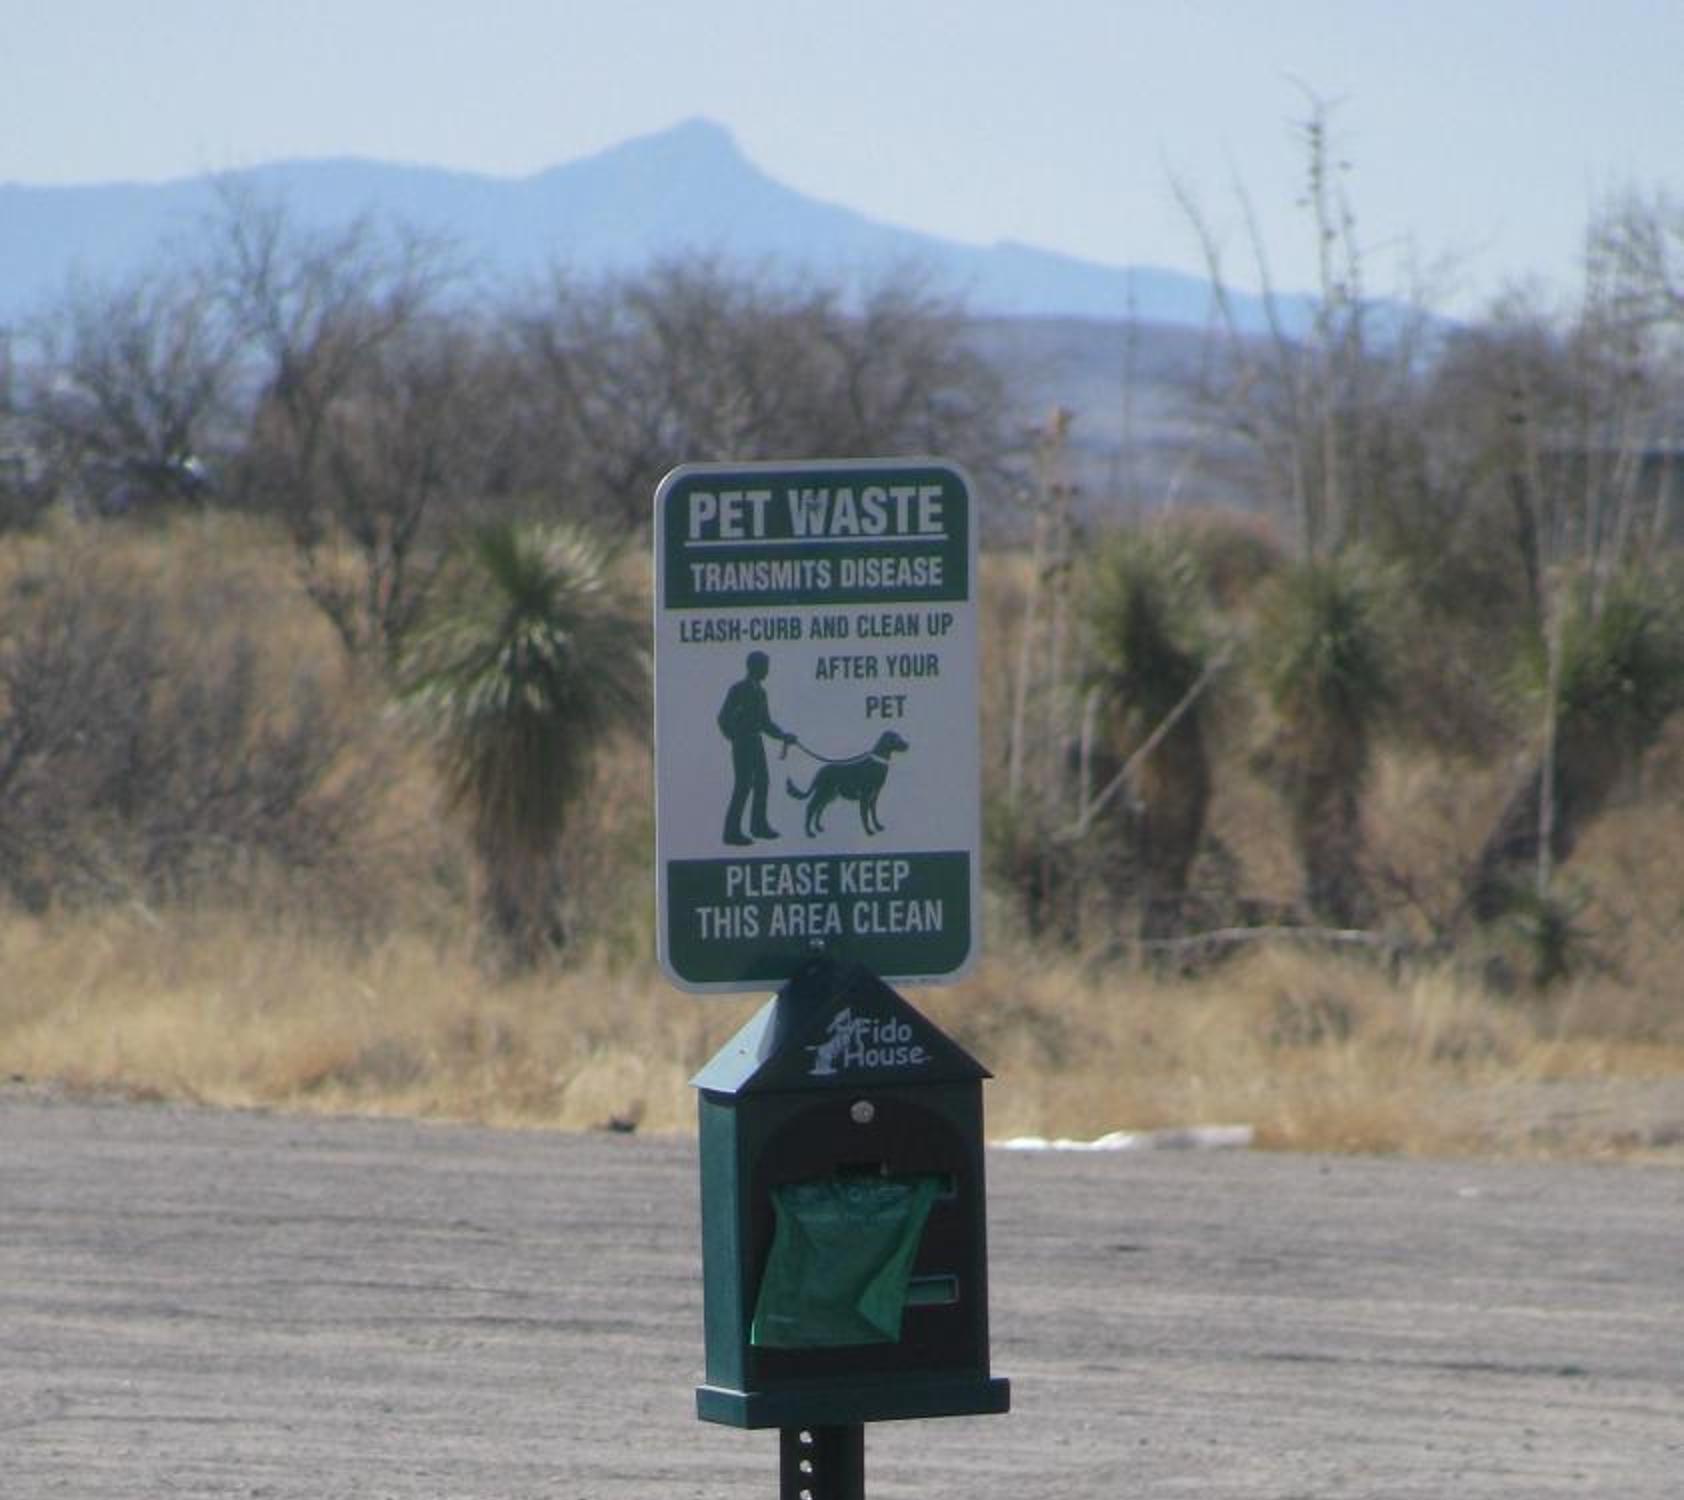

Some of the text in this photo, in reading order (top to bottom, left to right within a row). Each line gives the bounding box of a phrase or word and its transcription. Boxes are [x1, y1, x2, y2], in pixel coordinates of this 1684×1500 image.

[688, 485, 944, 539] PET WASTE
[690, 557, 943, 592] TRANSMITS DISEASE
[680, 613, 953, 643] LEASH-CURB AND CLEAN UP
[815, 654, 939, 680] AFTER YOUR
[865, 695, 907, 718] PET
[726, 860, 910, 897] PLEASE KEEP
[696, 899, 943, 940] THIS AREA CLEAN
[854, 1016, 912, 1044] Fido
[844, 1043, 926, 1068] House
